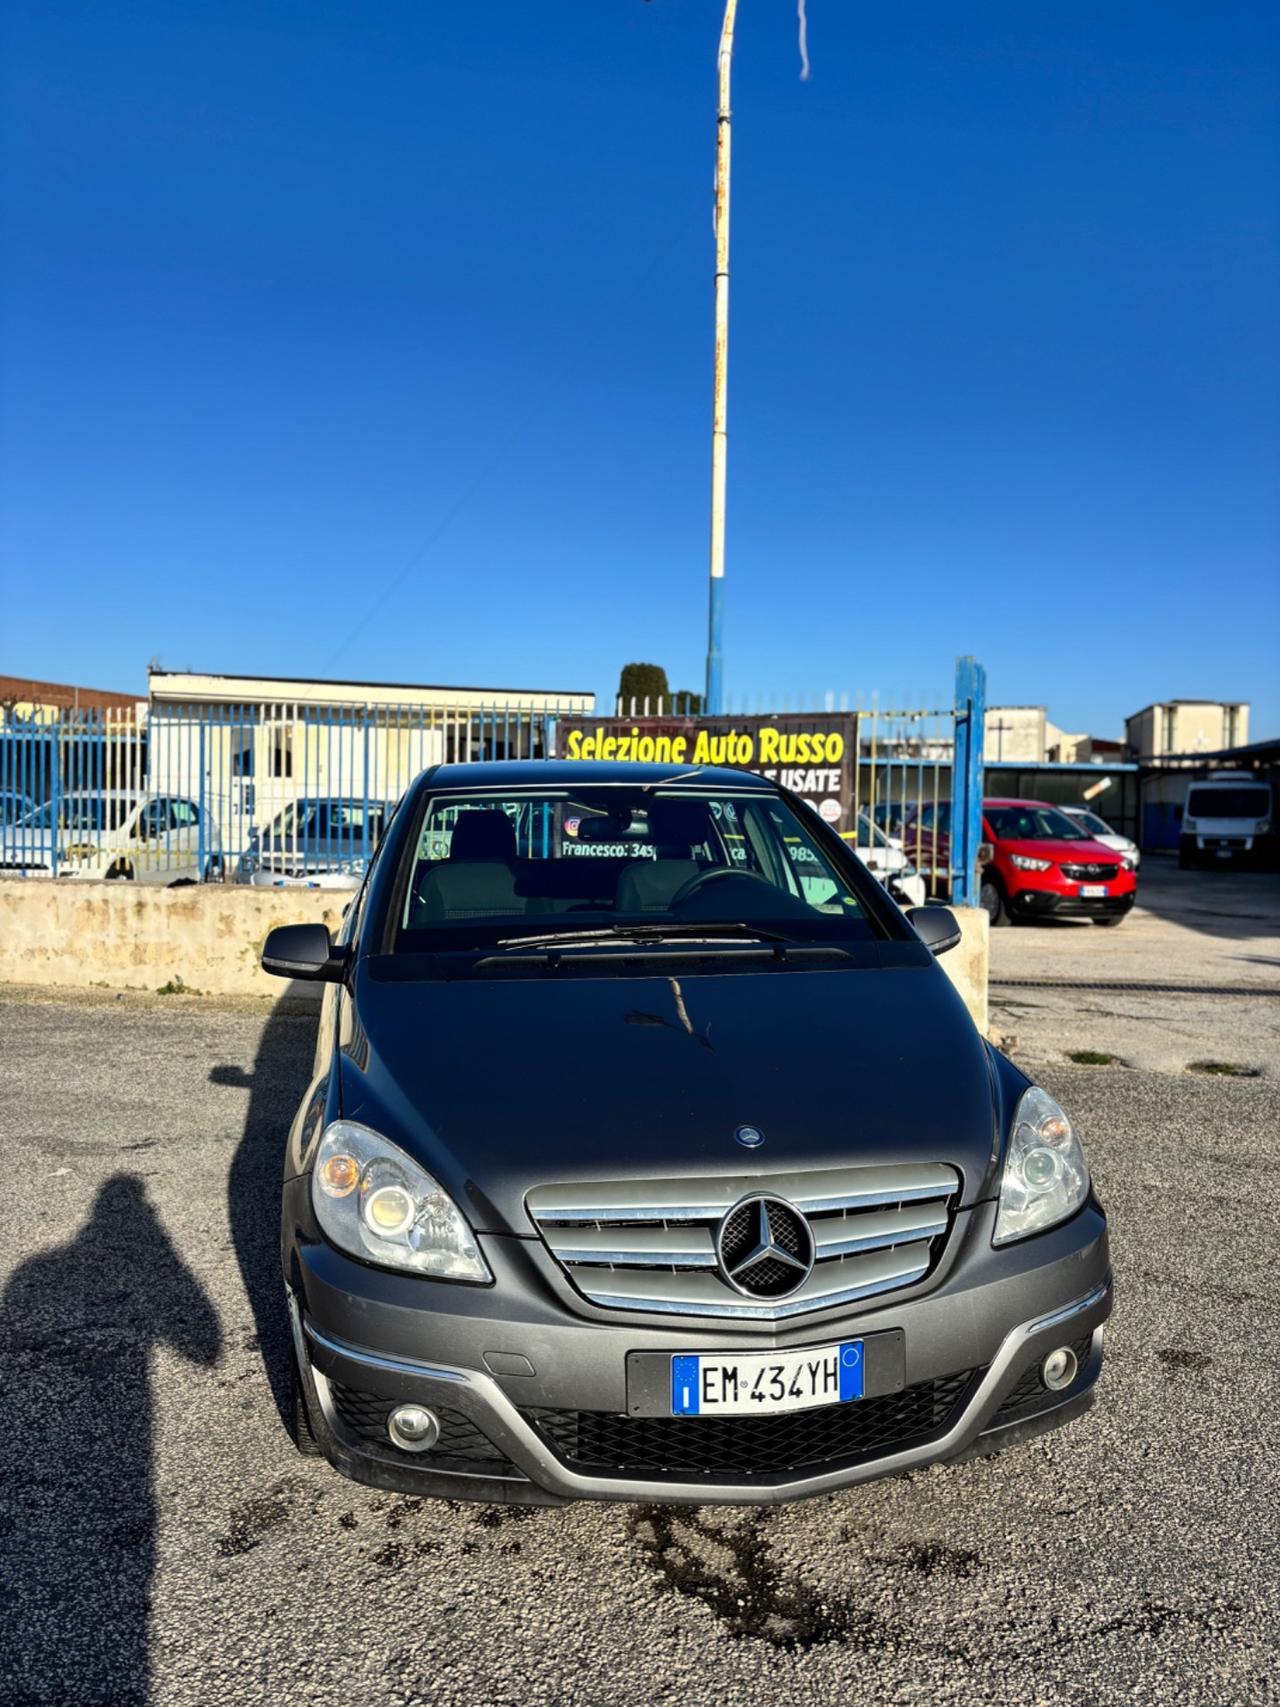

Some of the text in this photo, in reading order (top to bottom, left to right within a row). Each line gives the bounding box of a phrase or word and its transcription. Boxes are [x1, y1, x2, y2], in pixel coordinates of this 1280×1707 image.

[566, 727, 844, 764] Selezione Auto Russo
[780, 768, 841, 792] USATE
[562, 842, 629, 857] Francesco:
[703, 1356, 838, 1403] EM 434YH
